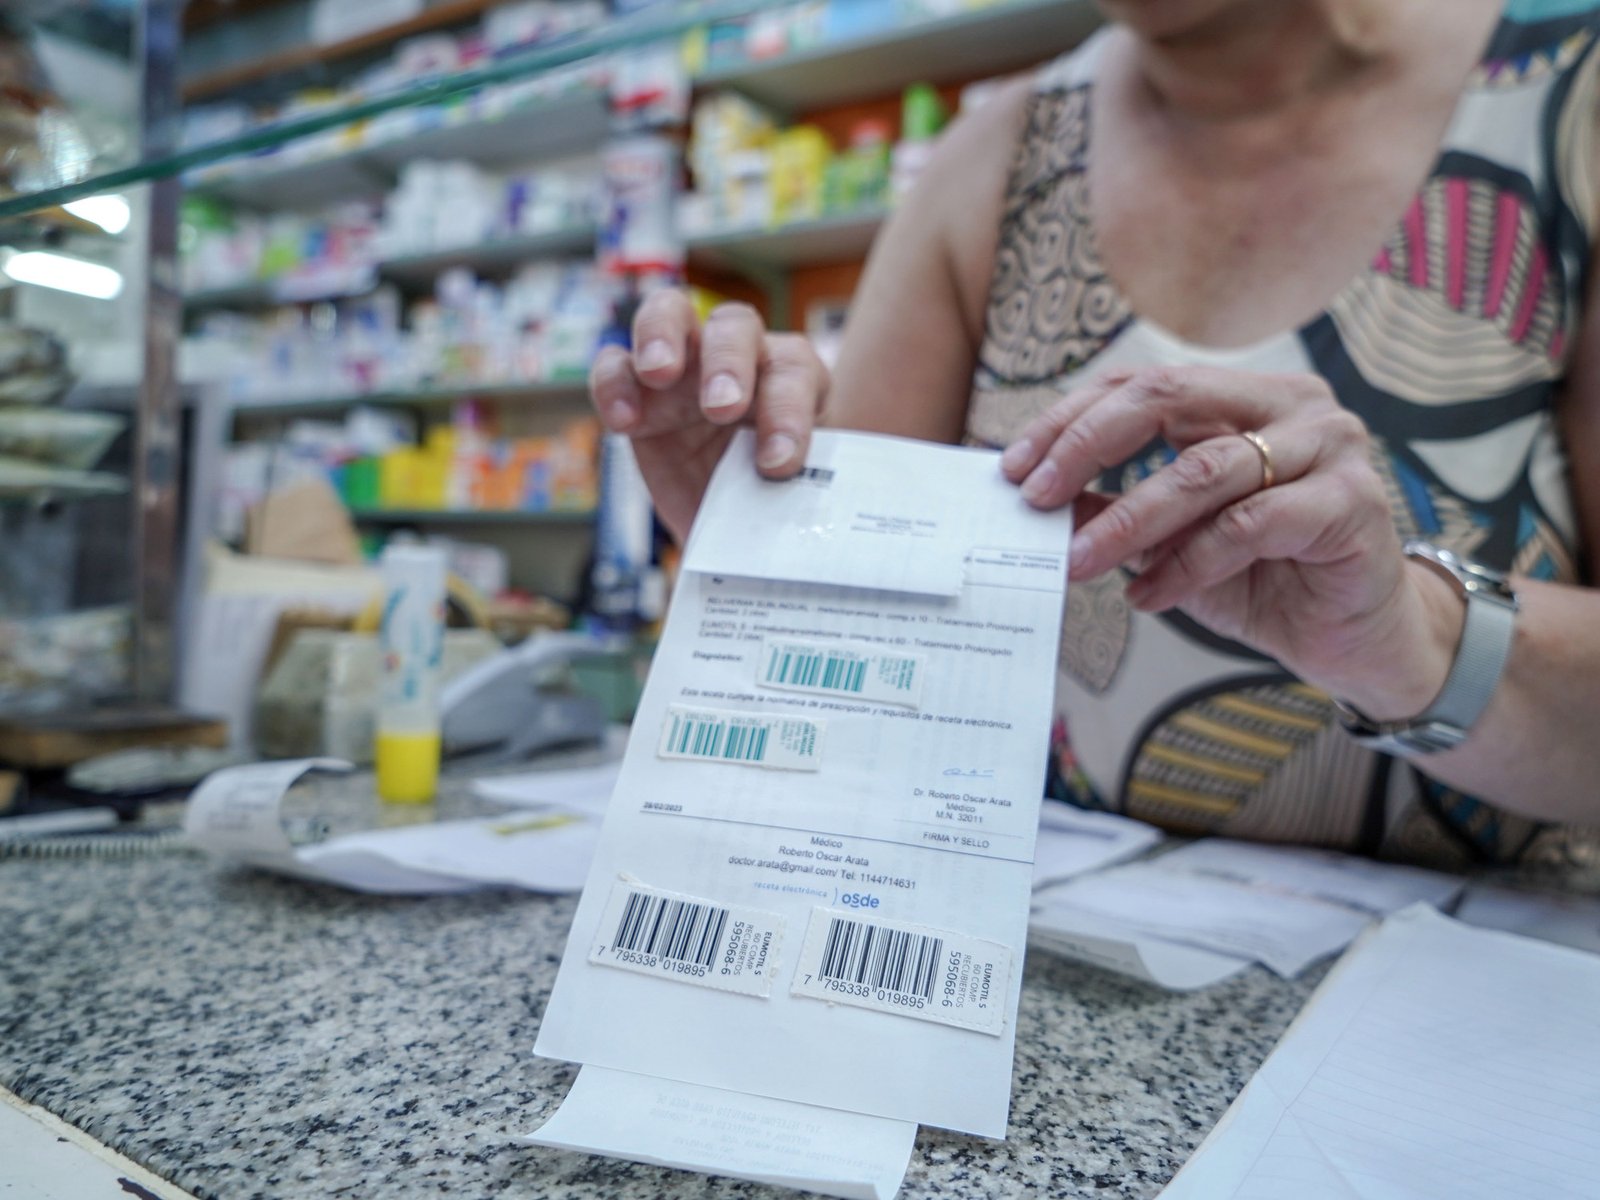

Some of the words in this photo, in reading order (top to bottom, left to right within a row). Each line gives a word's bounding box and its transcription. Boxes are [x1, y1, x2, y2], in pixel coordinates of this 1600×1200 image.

[936, 616, 984, 628] Tratamiento
[986, 622, 1034, 634] Prolongado
[914, 638, 962, 650] Tratamiento
[964, 644, 1012, 656] Prolongado
[767, 696, 805, 707] normativa
[808, 700, 818, 708] de
[820, 702, 871, 713] prescripción
[879, 708, 920, 720] requisitos
[922, 712, 933, 721] de
[935, 715, 962, 725] receta
[914, 788, 925, 797] Dr.
[928, 790, 960, 801] Roberto
[963, 793, 988, 803] Oscar
[989, 797, 1012, 807] Arata
[946, 802, 976, 813] Médico
[957, 813, 983, 824] 32011
[810, 836, 843, 849] Médico
[923, 831, 951, 843] FIRMA
[953, 836, 960, 844] Y
[961, 836, 990, 849] SELLO
[779, 845, 814, 858] Roberto
[815, 850, 842, 863] Oscar
[844, 855, 870, 867] Arata
[840, 870, 857, 881] Tel:
[861, 873, 916, 889] 1144714631
[753, 881, 780, 891] receta
[782, 883, 828, 898] electrónica
[841, 892, 880, 908] osde
[720, 920, 745, 976] 595068-6
[755, 932, 762, 945] 60
[733, 923, 754, 976] RECUBIERTOS
[758, 931, 772, 968] EUMOTIL
[597, 945, 607, 956] 7
[615, 949, 657, 968] 795338
[662, 959, 707, 978] 019895
[973, 963, 982, 975] 60
[941, 951, 962, 1009] 595068-6
[955, 954, 972, 1009] RECUBIERTOS
[982, 963, 993, 1000] EUMOTIL
[803, 973, 812, 985] 7
[824, 978, 870, 998] 795338
[877, 990, 925, 1009] 019895
